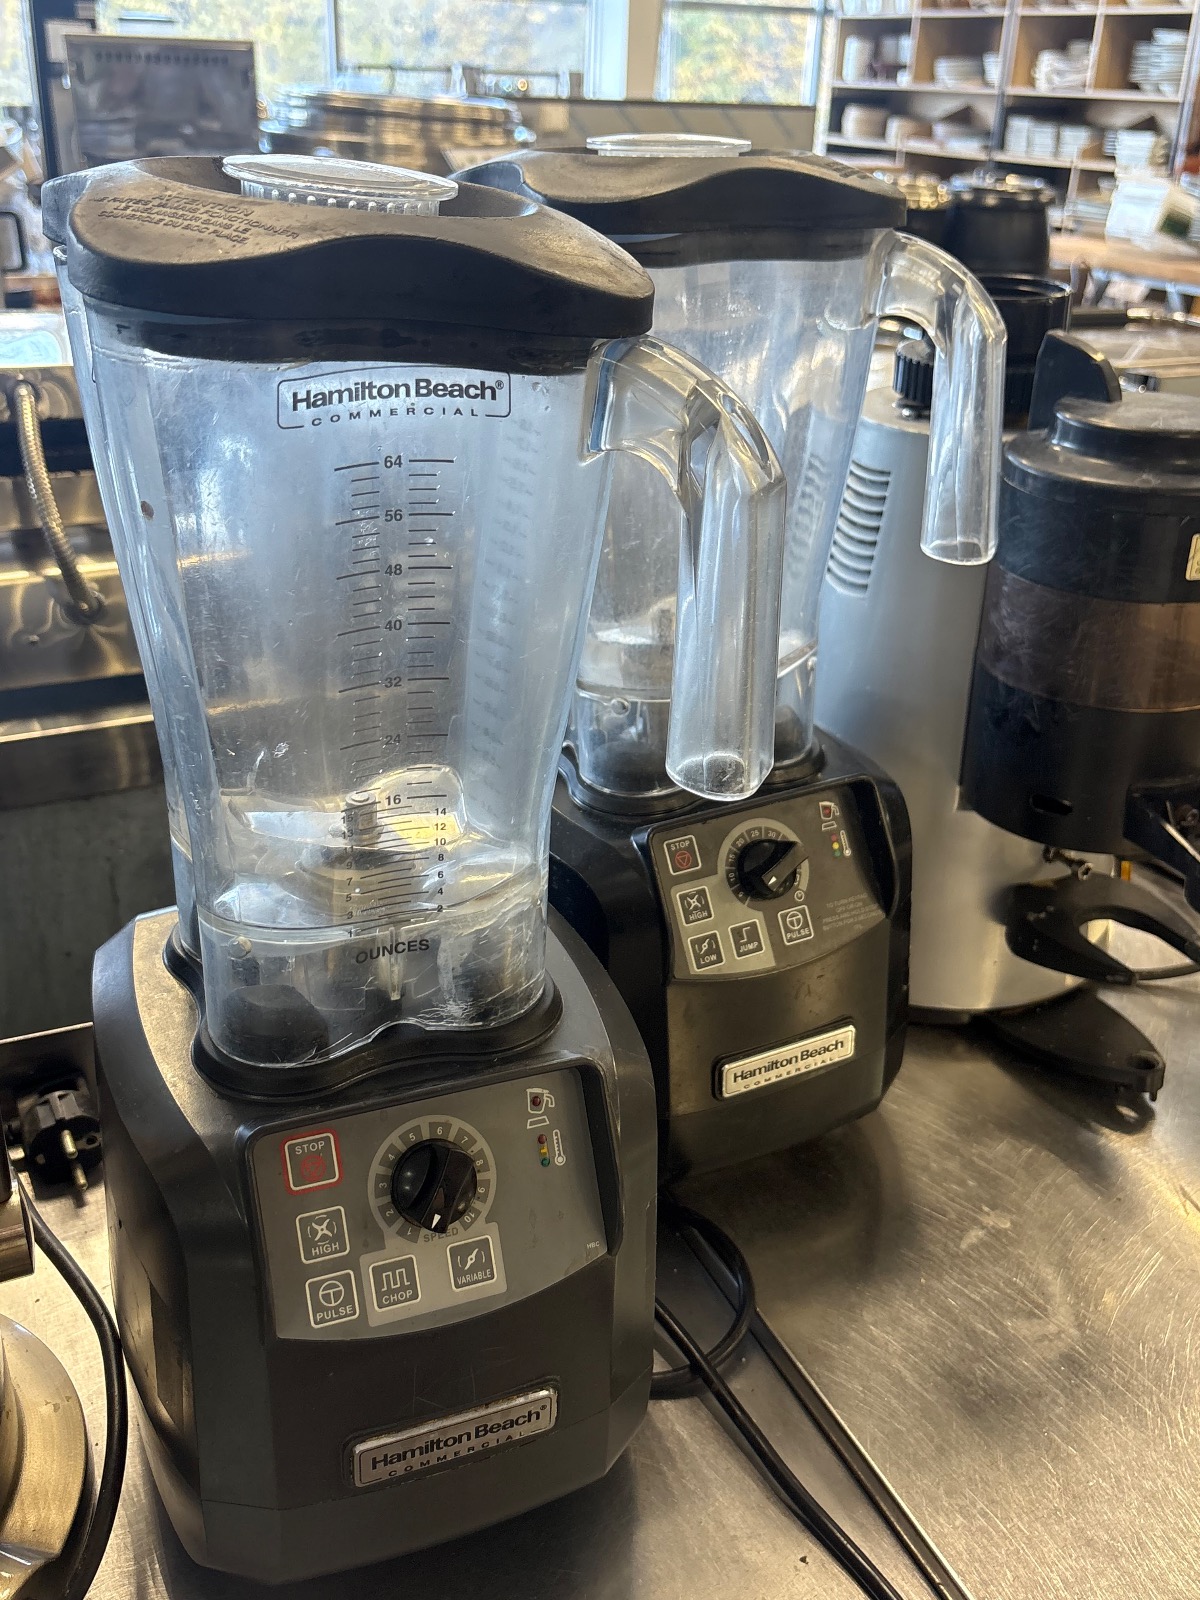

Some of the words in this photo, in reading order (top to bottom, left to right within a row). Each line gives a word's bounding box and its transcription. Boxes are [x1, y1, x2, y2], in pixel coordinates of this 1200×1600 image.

[151, 191, 255, 216] ATTENTION
[151, 201, 201, 214] JAMAIS
[199, 209, 300, 239] FONCTIONNER
[291, 379, 411, 412] Hamilton
[311, 406, 479, 427] COMMERCIAL
[383, 455, 404, 469] 64
[383, 509, 404, 523] 56
[383, 563, 404, 577] 48
[383, 618, 404, 632] 40
[384, 675, 403, 688] 32
[384, 733, 402, 747] 24
[384, 794, 402, 807] 16
[434, 807, 447, 817] 14
[341, 813, 354, 824] 15
[434, 822, 447, 832] 12
[341, 829, 354, 840] 13
[750, 829, 760, 838] 25
[767, 830, 777, 839] 30
[434, 837, 447, 847] 10
[670, 839, 690, 851] STOP
[437, 853, 444, 862] 8
[437, 870, 444, 880] 6
[346, 876, 353, 887] 7
[345, 892, 353, 902] 5
[437, 887, 444, 896] 4
[436, 904, 444, 913] 2
[346, 910, 354, 920] 3
[688, 910, 708, 921] HIGH
[786, 927, 810, 940] PULSE
[355, 938, 430, 965] OUNCES
[739, 941, 759, 953] JUMP
[700, 953, 717, 965] LOW
[733, 1053, 798, 1084] Hamilton
[799, 1038, 844, 1062] Beach
[743, 1056, 834, 1090] COMMERCIAL
[436, 1126, 443, 1135] 6
[408, 1132, 416, 1142] 5
[460, 1135, 469, 1144] 7
[294, 1139, 326, 1156] STOP
[388, 1153, 396, 1161] 4
[475, 1159, 484, 1167] 8
[378, 1181, 388, 1189] 3
[477, 1186, 486, 1194] 9
[385, 1208, 394, 1217] 2
[463, 1210, 476, 1224] 10
[406, 1227, 412, 1236] 1
[423, 1226, 459, 1243] SPEED
[310, 1241, 340, 1258] HIGH
[586, 1240, 600, 1250] HBC
[456, 1267, 492, 1287] VARIABLE
[382, 1288, 414, 1306] CHOP
[316, 1304, 354, 1323] PULSE
[371, 1431, 472, 1471] Hamilton
[388, 1430, 526, 1478] COMMERCIAL
